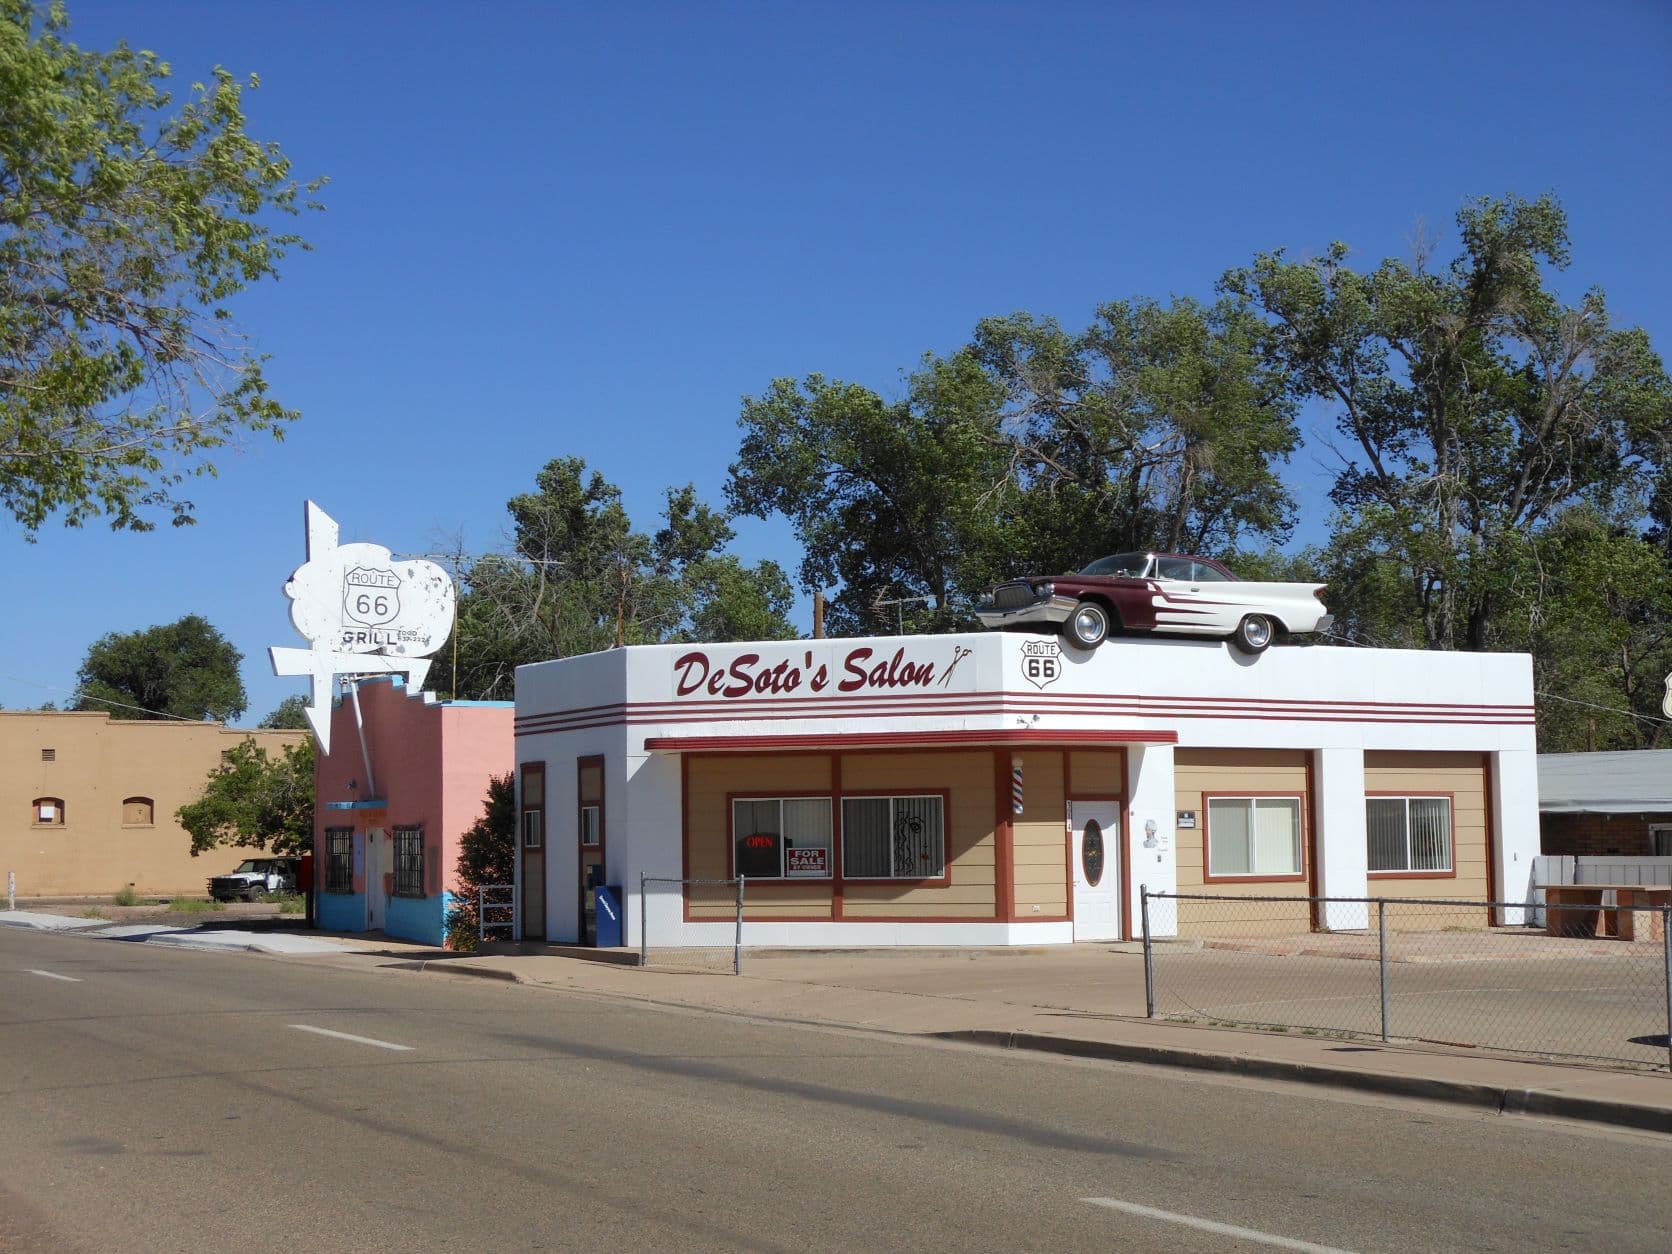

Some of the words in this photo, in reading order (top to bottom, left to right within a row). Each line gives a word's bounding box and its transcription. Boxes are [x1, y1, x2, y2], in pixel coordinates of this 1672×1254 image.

[351, 572, 394, 586] ROUTE
[356, 594, 388, 615] 66
[342, 631, 397, 645] GRILL
[1026, 644, 1056, 655] ROUTE
[674, 650, 830, 698] DeSoto's
[838, 647, 935, 692] Salon
[1028, 658, 1055, 678] 66
[746, 836, 774, 848] OPEN
[790, 857, 825, 865] SALE
